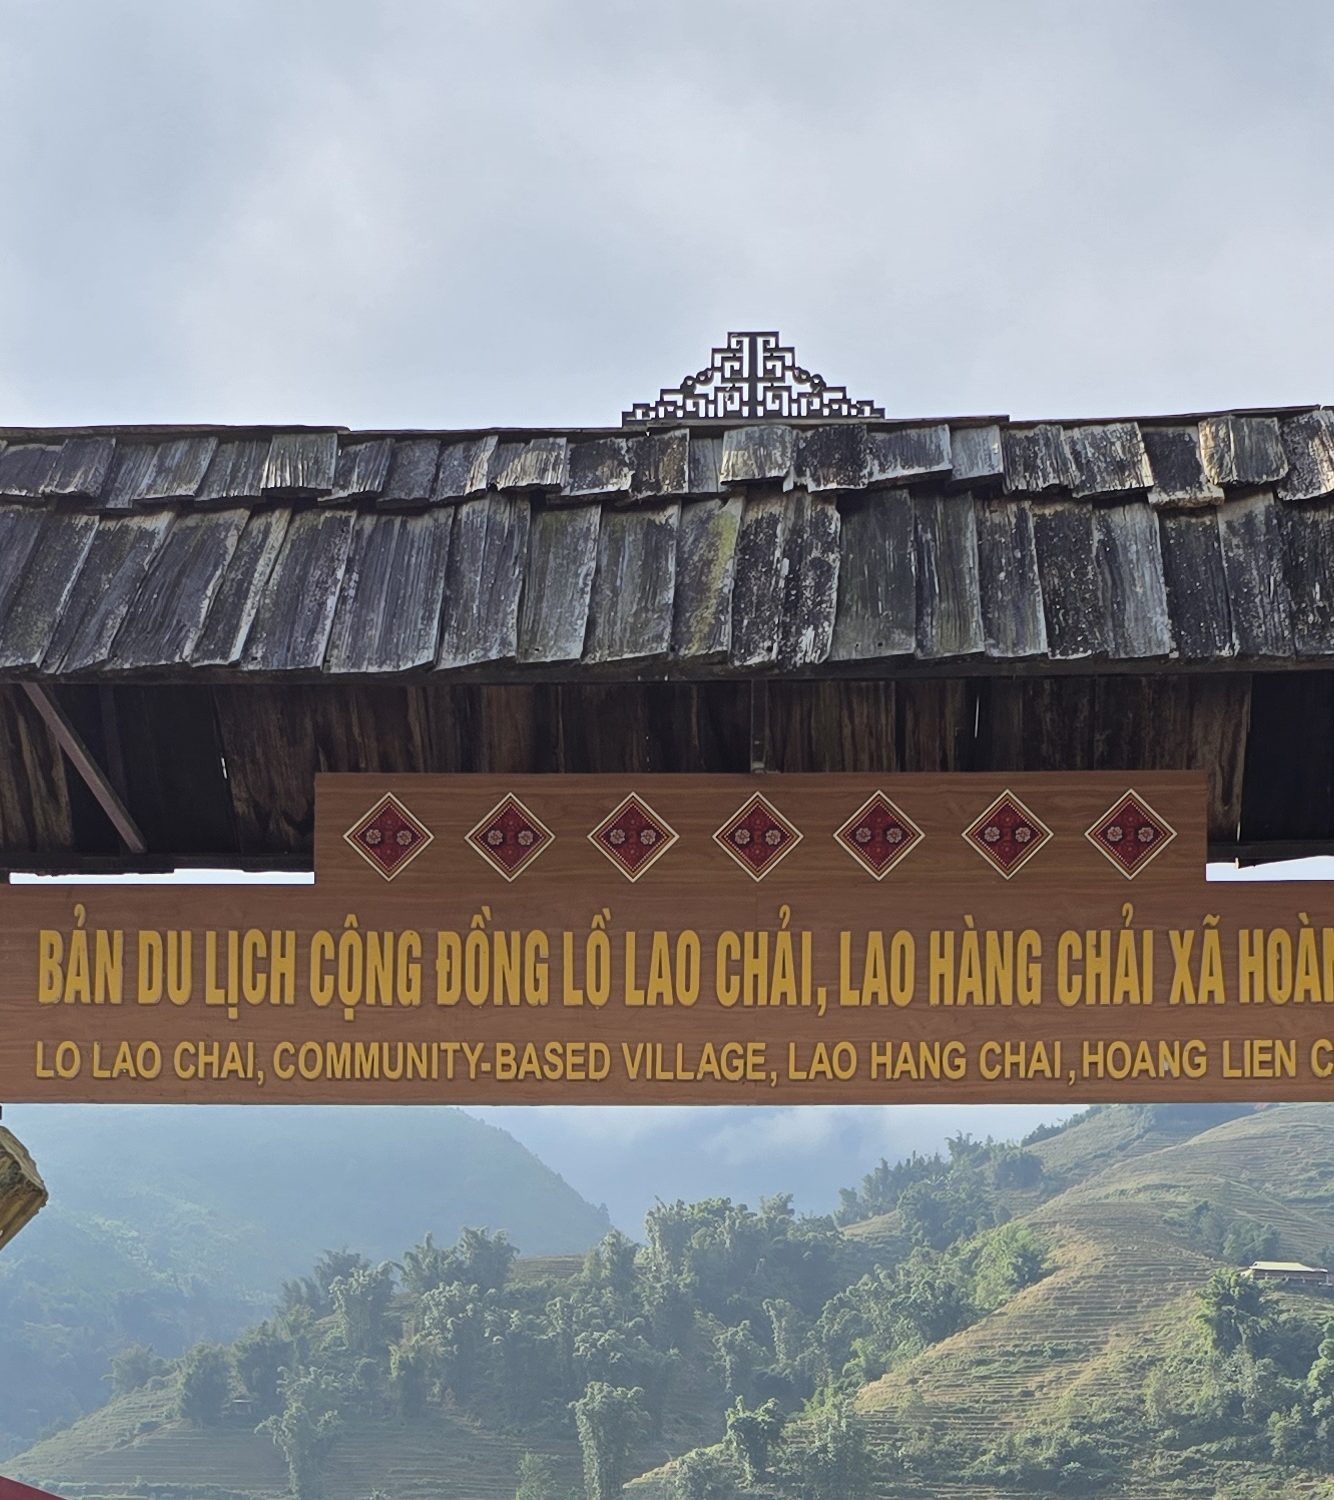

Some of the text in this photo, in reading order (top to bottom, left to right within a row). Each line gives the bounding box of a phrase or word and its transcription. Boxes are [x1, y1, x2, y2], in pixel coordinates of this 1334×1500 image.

[36, 902, 125, 1006] BẢN
[136, 928, 194, 1006] DU
[204, 927, 297, 1021] LỊCH
[308, 912, 423, 1022] CỘNG
[435, 904, 551, 1008] ĐỒNG
[561, 905, 613, 1008] LỒ
[623, 928, 702, 1008] LAO
[714, 903, 829, 1018] CHẢI,
[838, 928, 917, 1008] LAO
[928, 913, 1043, 1008] HÀNG
[1056, 901, 1155, 1008] CHẢI
[1167, 912, 1227, 1006] XÃ
[35, 1040, 83, 1080] LO
[91, 1040, 163, 1080] LAO
[172, 1040, 265, 1086] CHAI,
[271, 1040, 612, 1081] COMMUNITY-BASED
[619, 1040, 779, 1088] VILLAGE,
[787, 1040, 859, 1081] LAO
[869, 1040, 968, 1081] HANG
[1081, 1038, 1209, 1080] HOANG
[1221, 1038, 1298, 1079] LIEN
